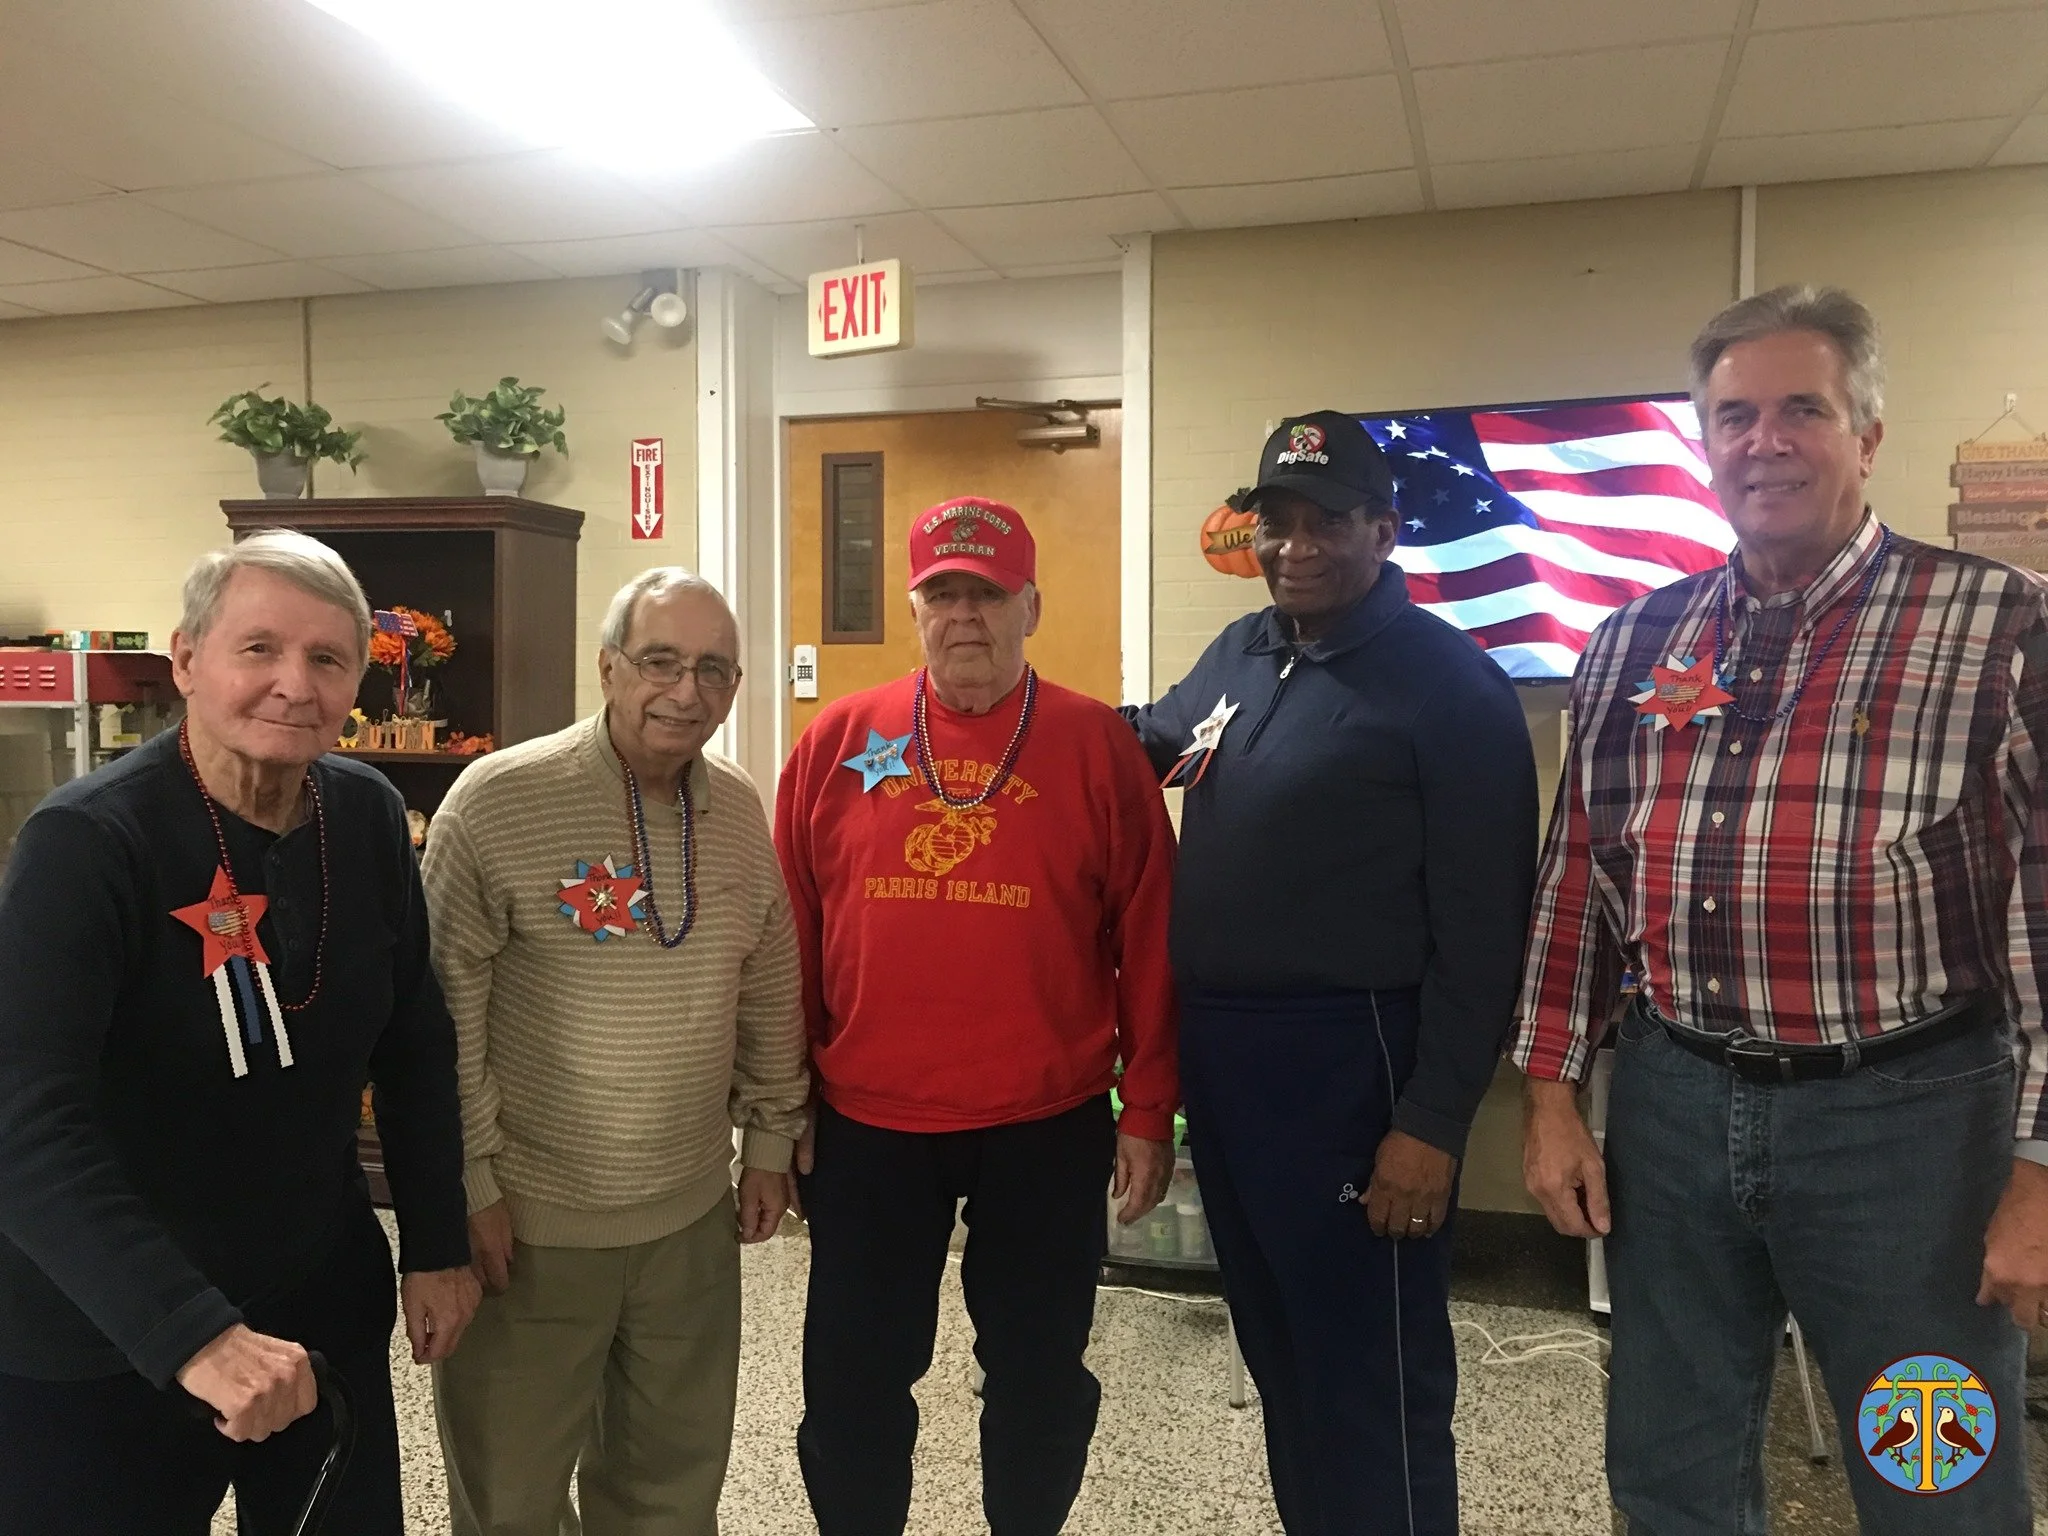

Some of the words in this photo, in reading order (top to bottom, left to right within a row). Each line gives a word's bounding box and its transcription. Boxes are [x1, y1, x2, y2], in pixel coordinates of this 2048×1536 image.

[824, 271, 886, 342] EXIT
[636, 448, 658, 462] FIRE
[1961, 445, 1995, 460] GIVE
[644, 464, 652, 531] EXTINGUISHER
[922, 515, 943, 535] U.S.
[941, 505, 983, 522] MARINE
[983, 510, 1012, 536] CORPS
[933, 542, 996, 557] VETERAN
[1223, 530, 1257, 550] We
[1670, 674, 1702, 683] Thank
[358, 721, 435, 749] AUTUMN
[880, 759, 1039, 805] UNIERSTY
[864, 877, 939, 899] PARRIS
[945, 880, 1031, 908] ISLAND
